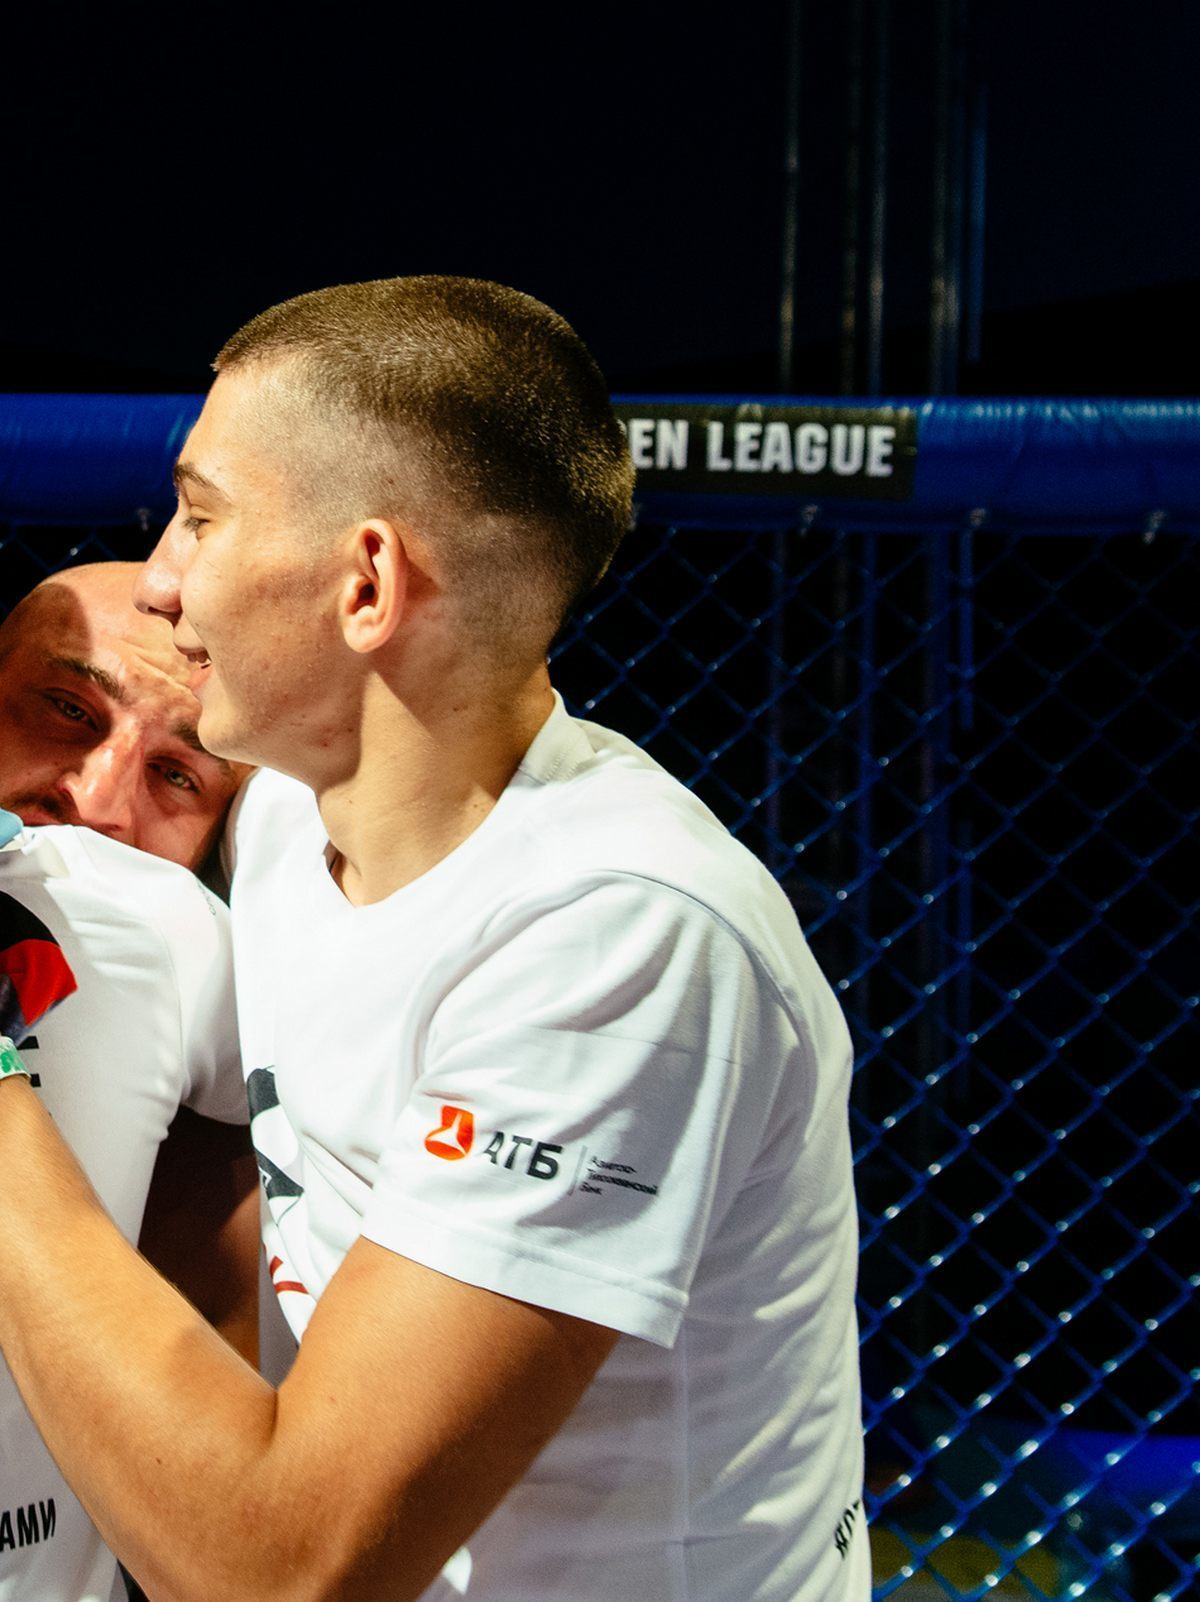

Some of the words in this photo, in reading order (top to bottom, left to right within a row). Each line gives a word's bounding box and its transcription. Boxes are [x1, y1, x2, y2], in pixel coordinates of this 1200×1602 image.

[617, 418, 689, 470] EN
[706, 420, 896, 477] LEAGUE
[483, 1131, 563, 1181] АТБ
